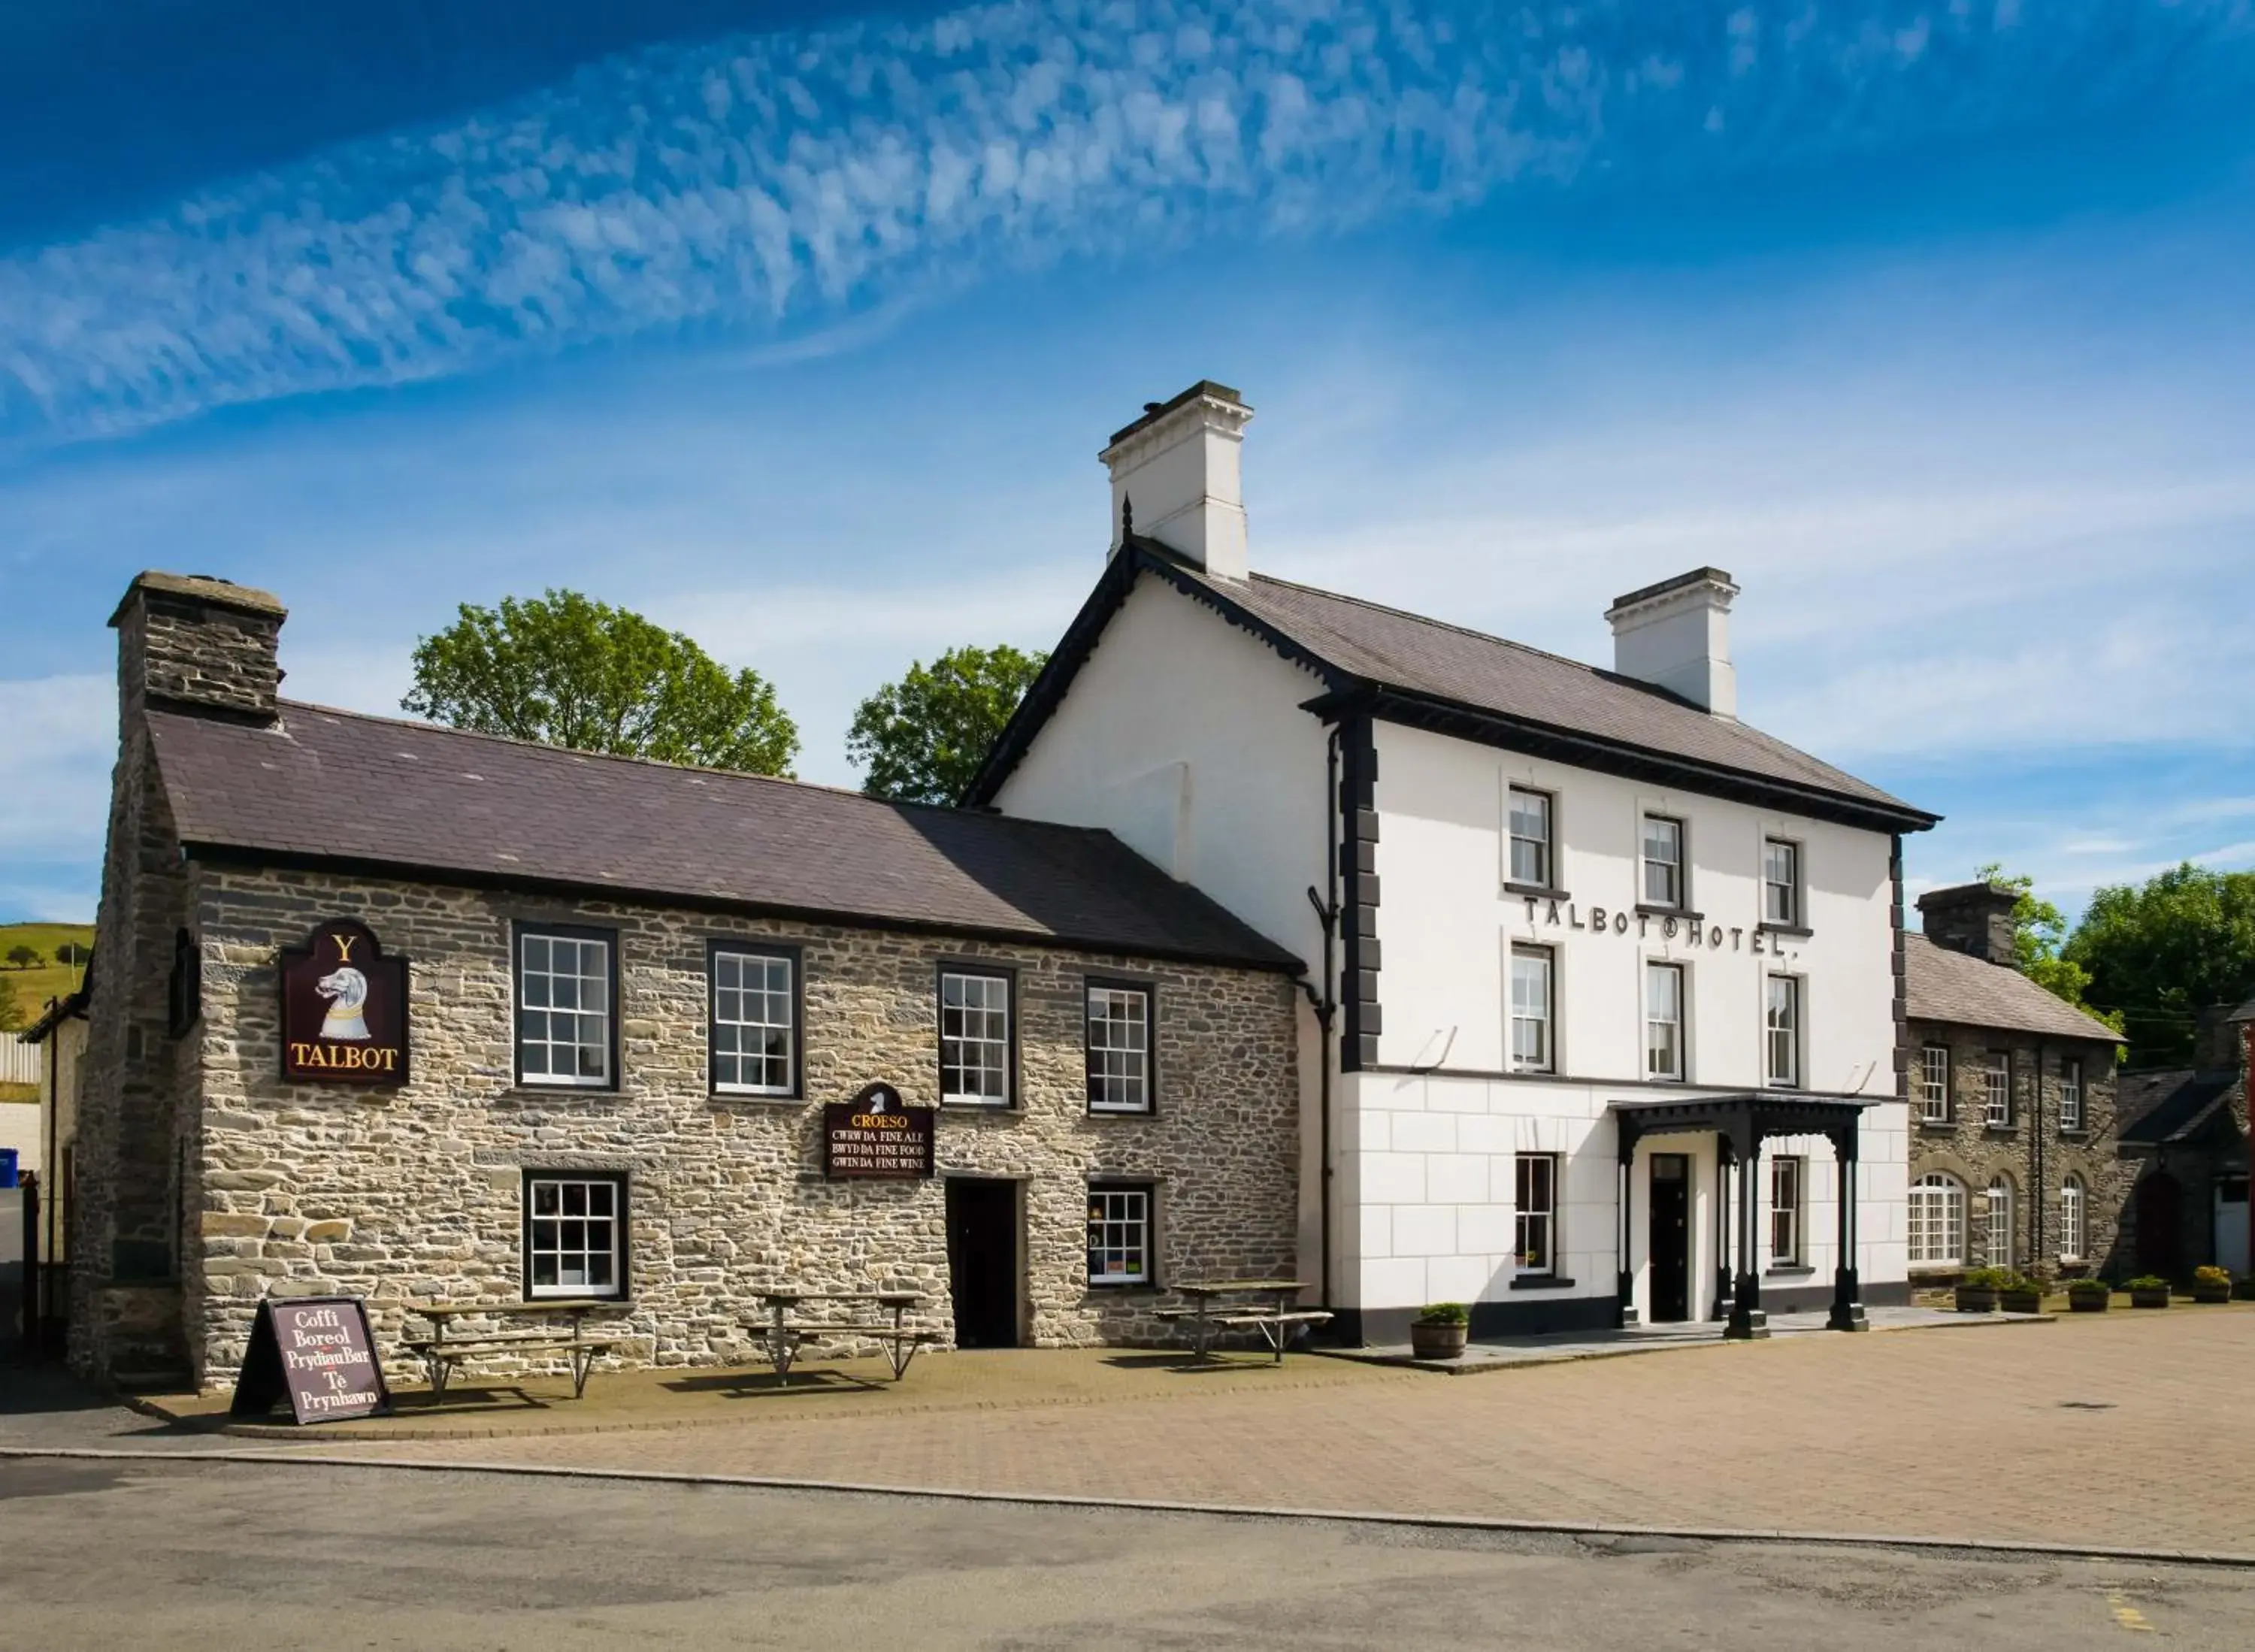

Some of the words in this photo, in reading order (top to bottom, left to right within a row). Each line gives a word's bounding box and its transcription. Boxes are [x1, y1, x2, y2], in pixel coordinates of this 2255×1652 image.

[1524, 897, 1650, 937] TALBOT
[331, 934, 358, 962] Y
[291, 1043, 398, 1070] TALBOT
[852, 1114, 908, 1128] CROESO
[832, 1130, 862, 1141] CWRW
[864, 1131, 876, 1142] DA
[880, 1131, 903, 1142] FINE
[904, 1132, 925, 1143] ALE
[832, 1143, 860, 1154] BWYD
[861, 1144, 873, 1154] DA
[876, 1145, 898, 1155] FINE
[900, 1145, 925, 1156] FOOD
[832, 1157, 859, 1167] GWIN
[859, 1157, 873, 1168] DA
[876, 1157, 898, 1169] FINE
[900, 1158, 925, 1169] WINE
[295, 1309, 339, 1328] Coffi
[292, 1327, 352, 1348] Boreol
[301, 1390, 377, 1411] Prynhawn
